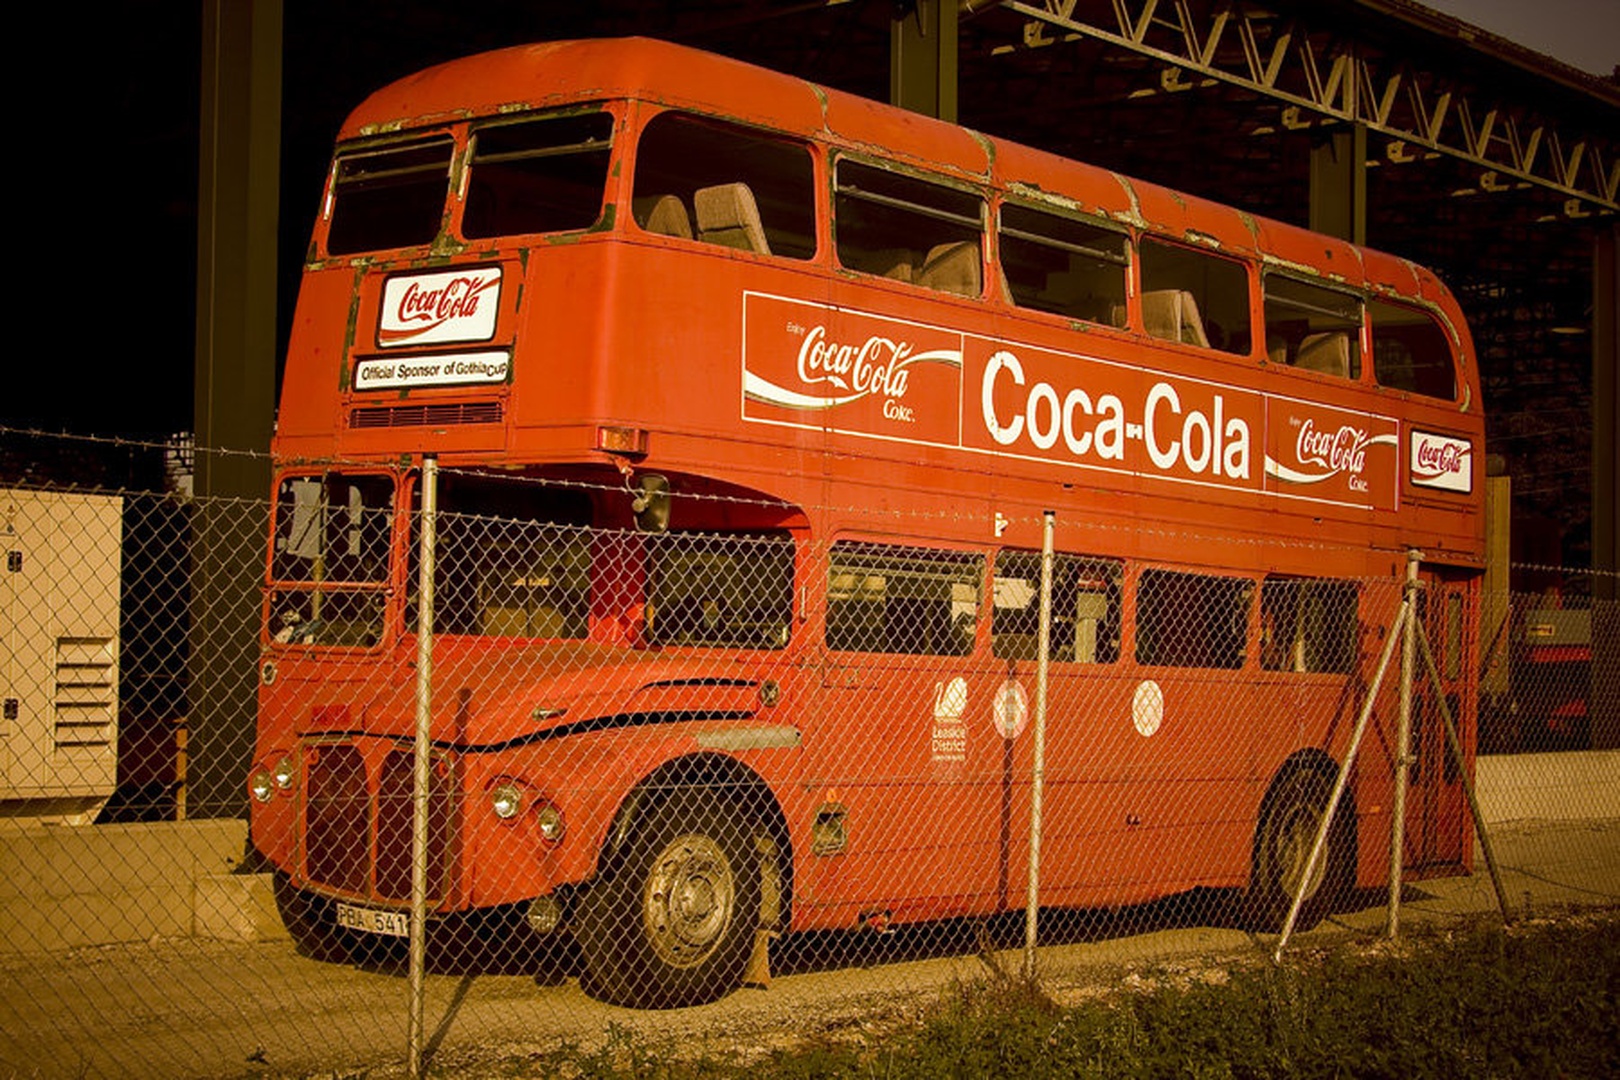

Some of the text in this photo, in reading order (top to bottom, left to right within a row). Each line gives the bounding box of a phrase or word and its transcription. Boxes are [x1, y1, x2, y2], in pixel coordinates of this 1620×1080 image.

[398, 277, 484, 322] Coca-Cola
[361, 366, 395, 380] Official
[397, 364, 440, 380] Sponsor
[443, 361, 455, 375] of
[797, 325, 914, 398] Coca-Cola
[982, 350, 1250, 479] Coca-Cola
[1296, 419, 1368, 473] Coca-Cola
[1417, 438, 1462, 473] Coca-Cola
[374, 912, 405, 934] 541
